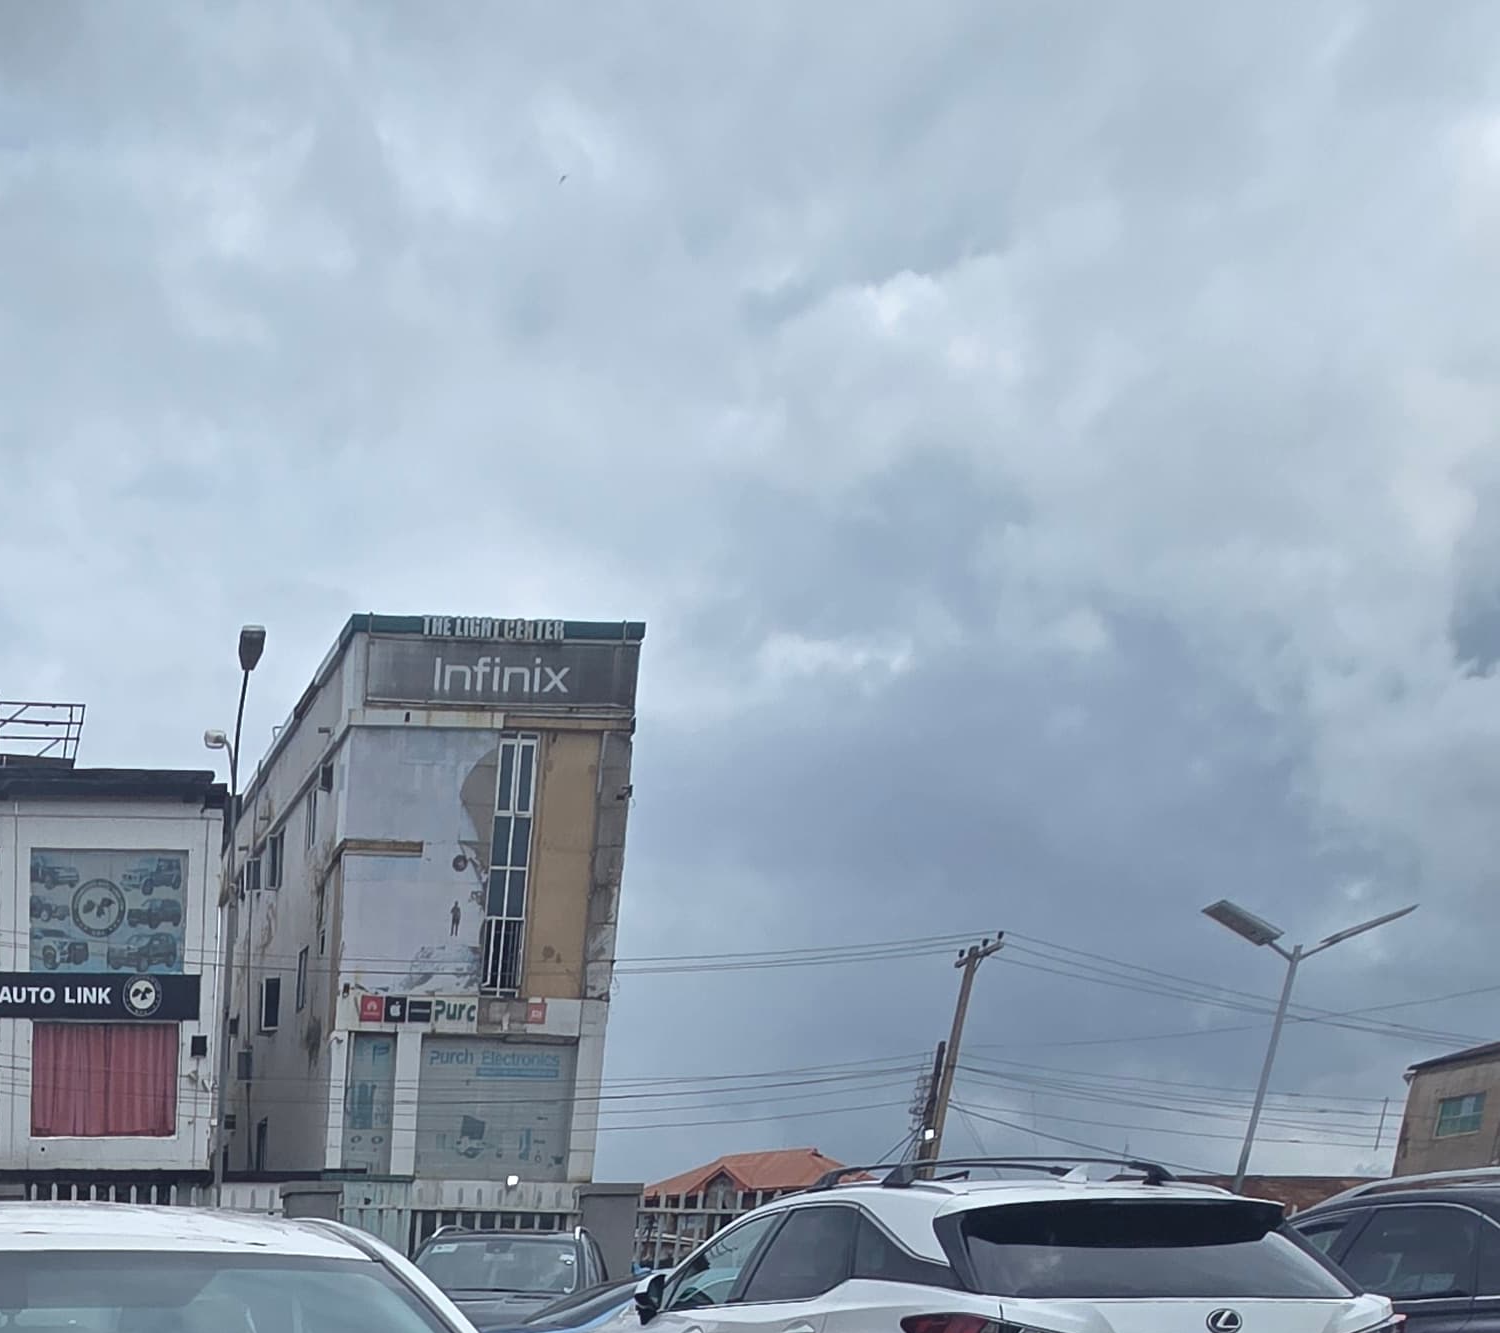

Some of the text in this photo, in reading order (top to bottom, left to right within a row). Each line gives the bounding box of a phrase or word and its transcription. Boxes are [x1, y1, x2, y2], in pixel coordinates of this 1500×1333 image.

[423, 615, 564, 641] THE LIGHT CENTER
[434, 657, 570, 693] Infinix
[64, 986, 111, 1004] LINK
[430, 1048, 560, 1067] Purch Electronics
